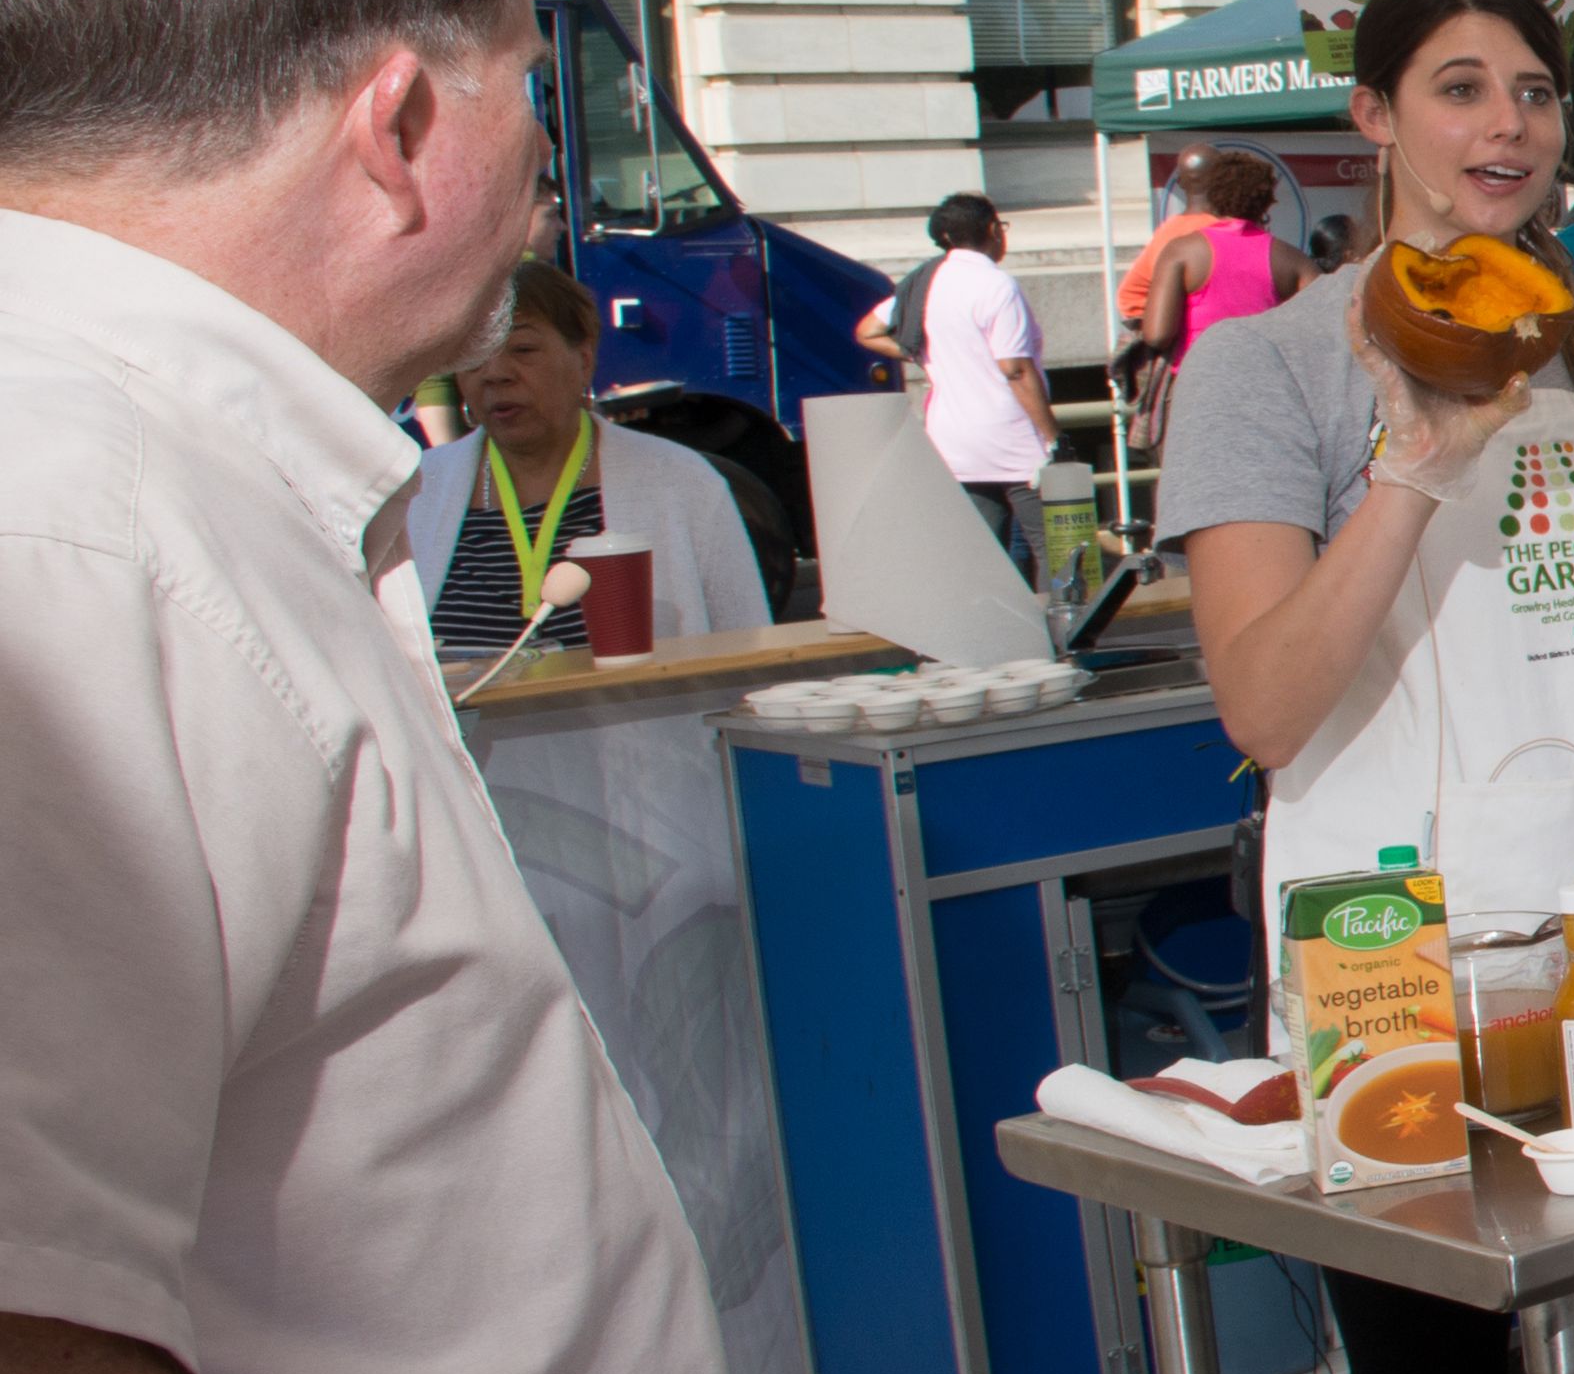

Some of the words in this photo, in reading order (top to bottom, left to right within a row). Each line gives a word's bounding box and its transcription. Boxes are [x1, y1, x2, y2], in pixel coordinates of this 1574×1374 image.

[1174, 62, 1284, 101] FARMERS
[1503, 544, 1544, 564] THE
[1512, 601, 1551, 614] Growing
[1541, 613, 1561, 625] and
[1333, 906, 1413, 940] Pacific
[1351, 956, 1401, 973] organic
[1318, 975, 1440, 1011] vegetable
[1344, 1007, 1419, 1039] broth
